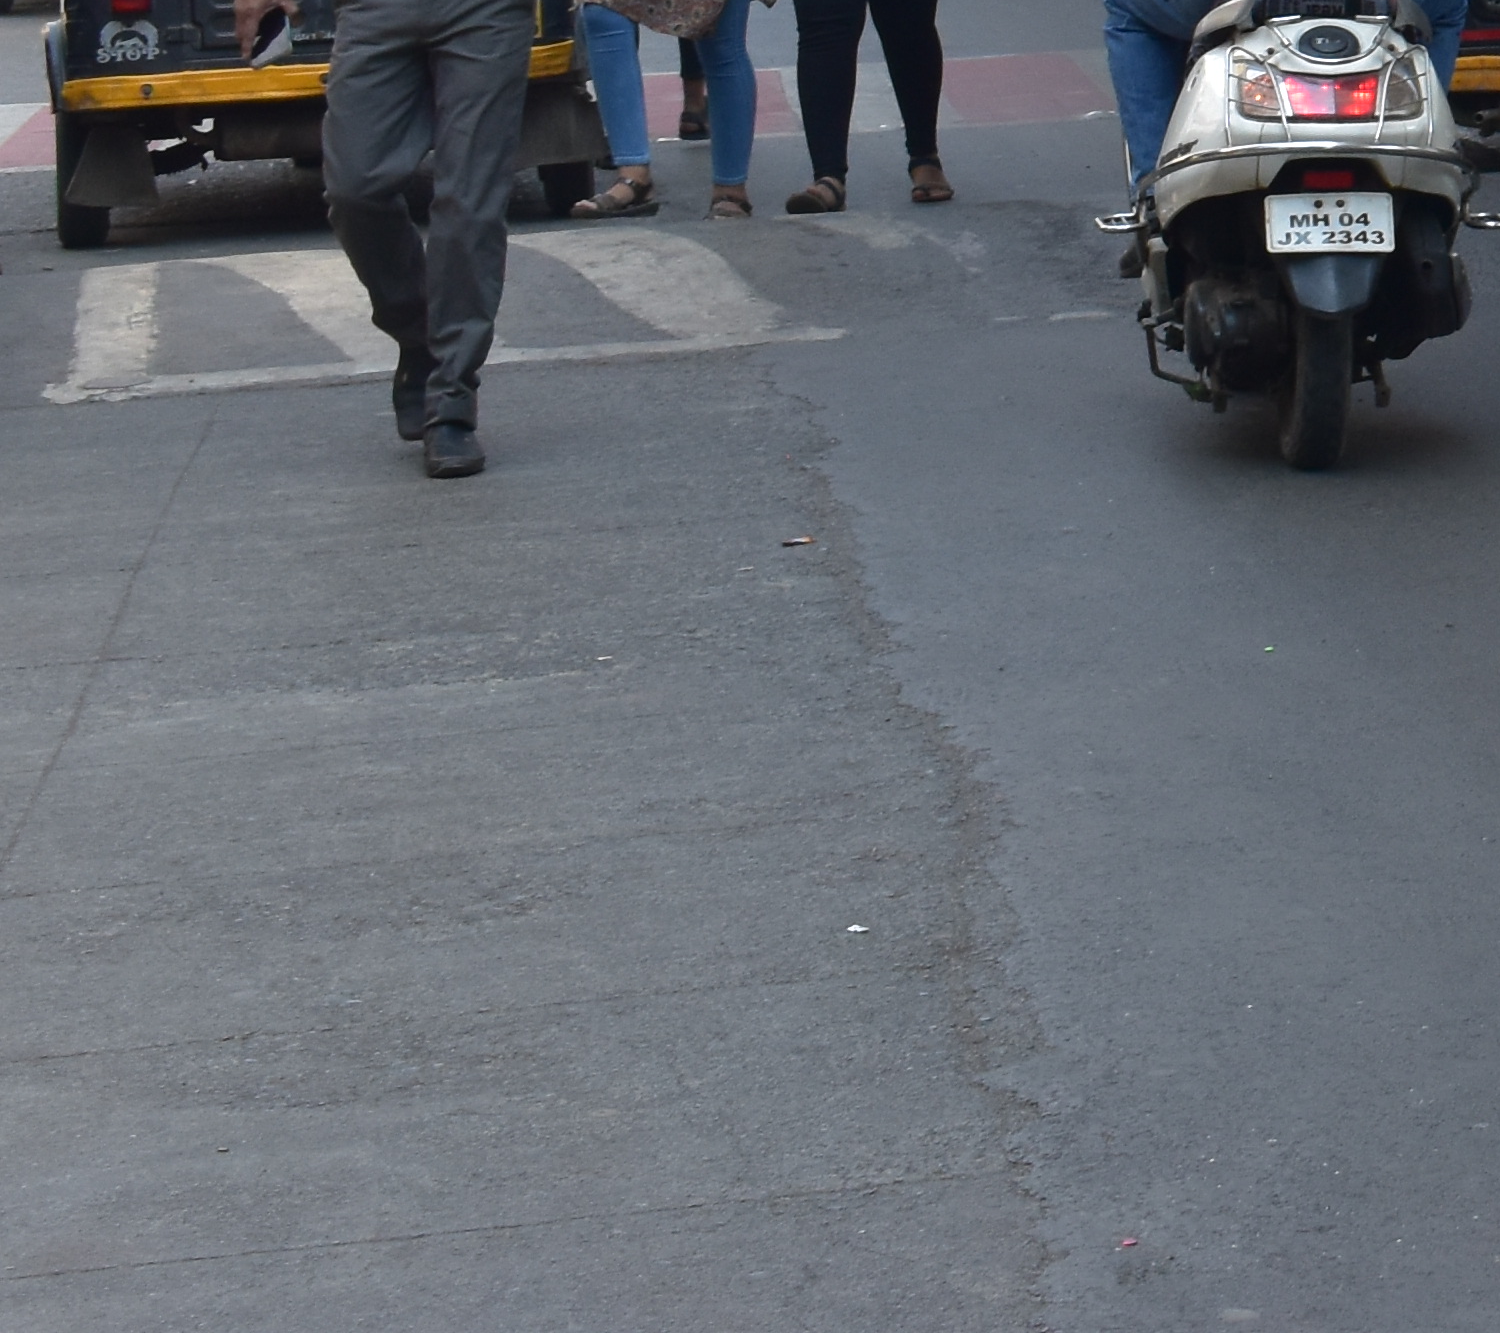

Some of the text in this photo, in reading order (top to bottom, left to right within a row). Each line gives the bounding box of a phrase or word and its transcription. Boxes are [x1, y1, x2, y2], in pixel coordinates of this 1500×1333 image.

[96, 49, 160, 63] STOP
[1289, 210, 1372, 230] MH 04
[1275, 228, 1386, 248] JX 2343
